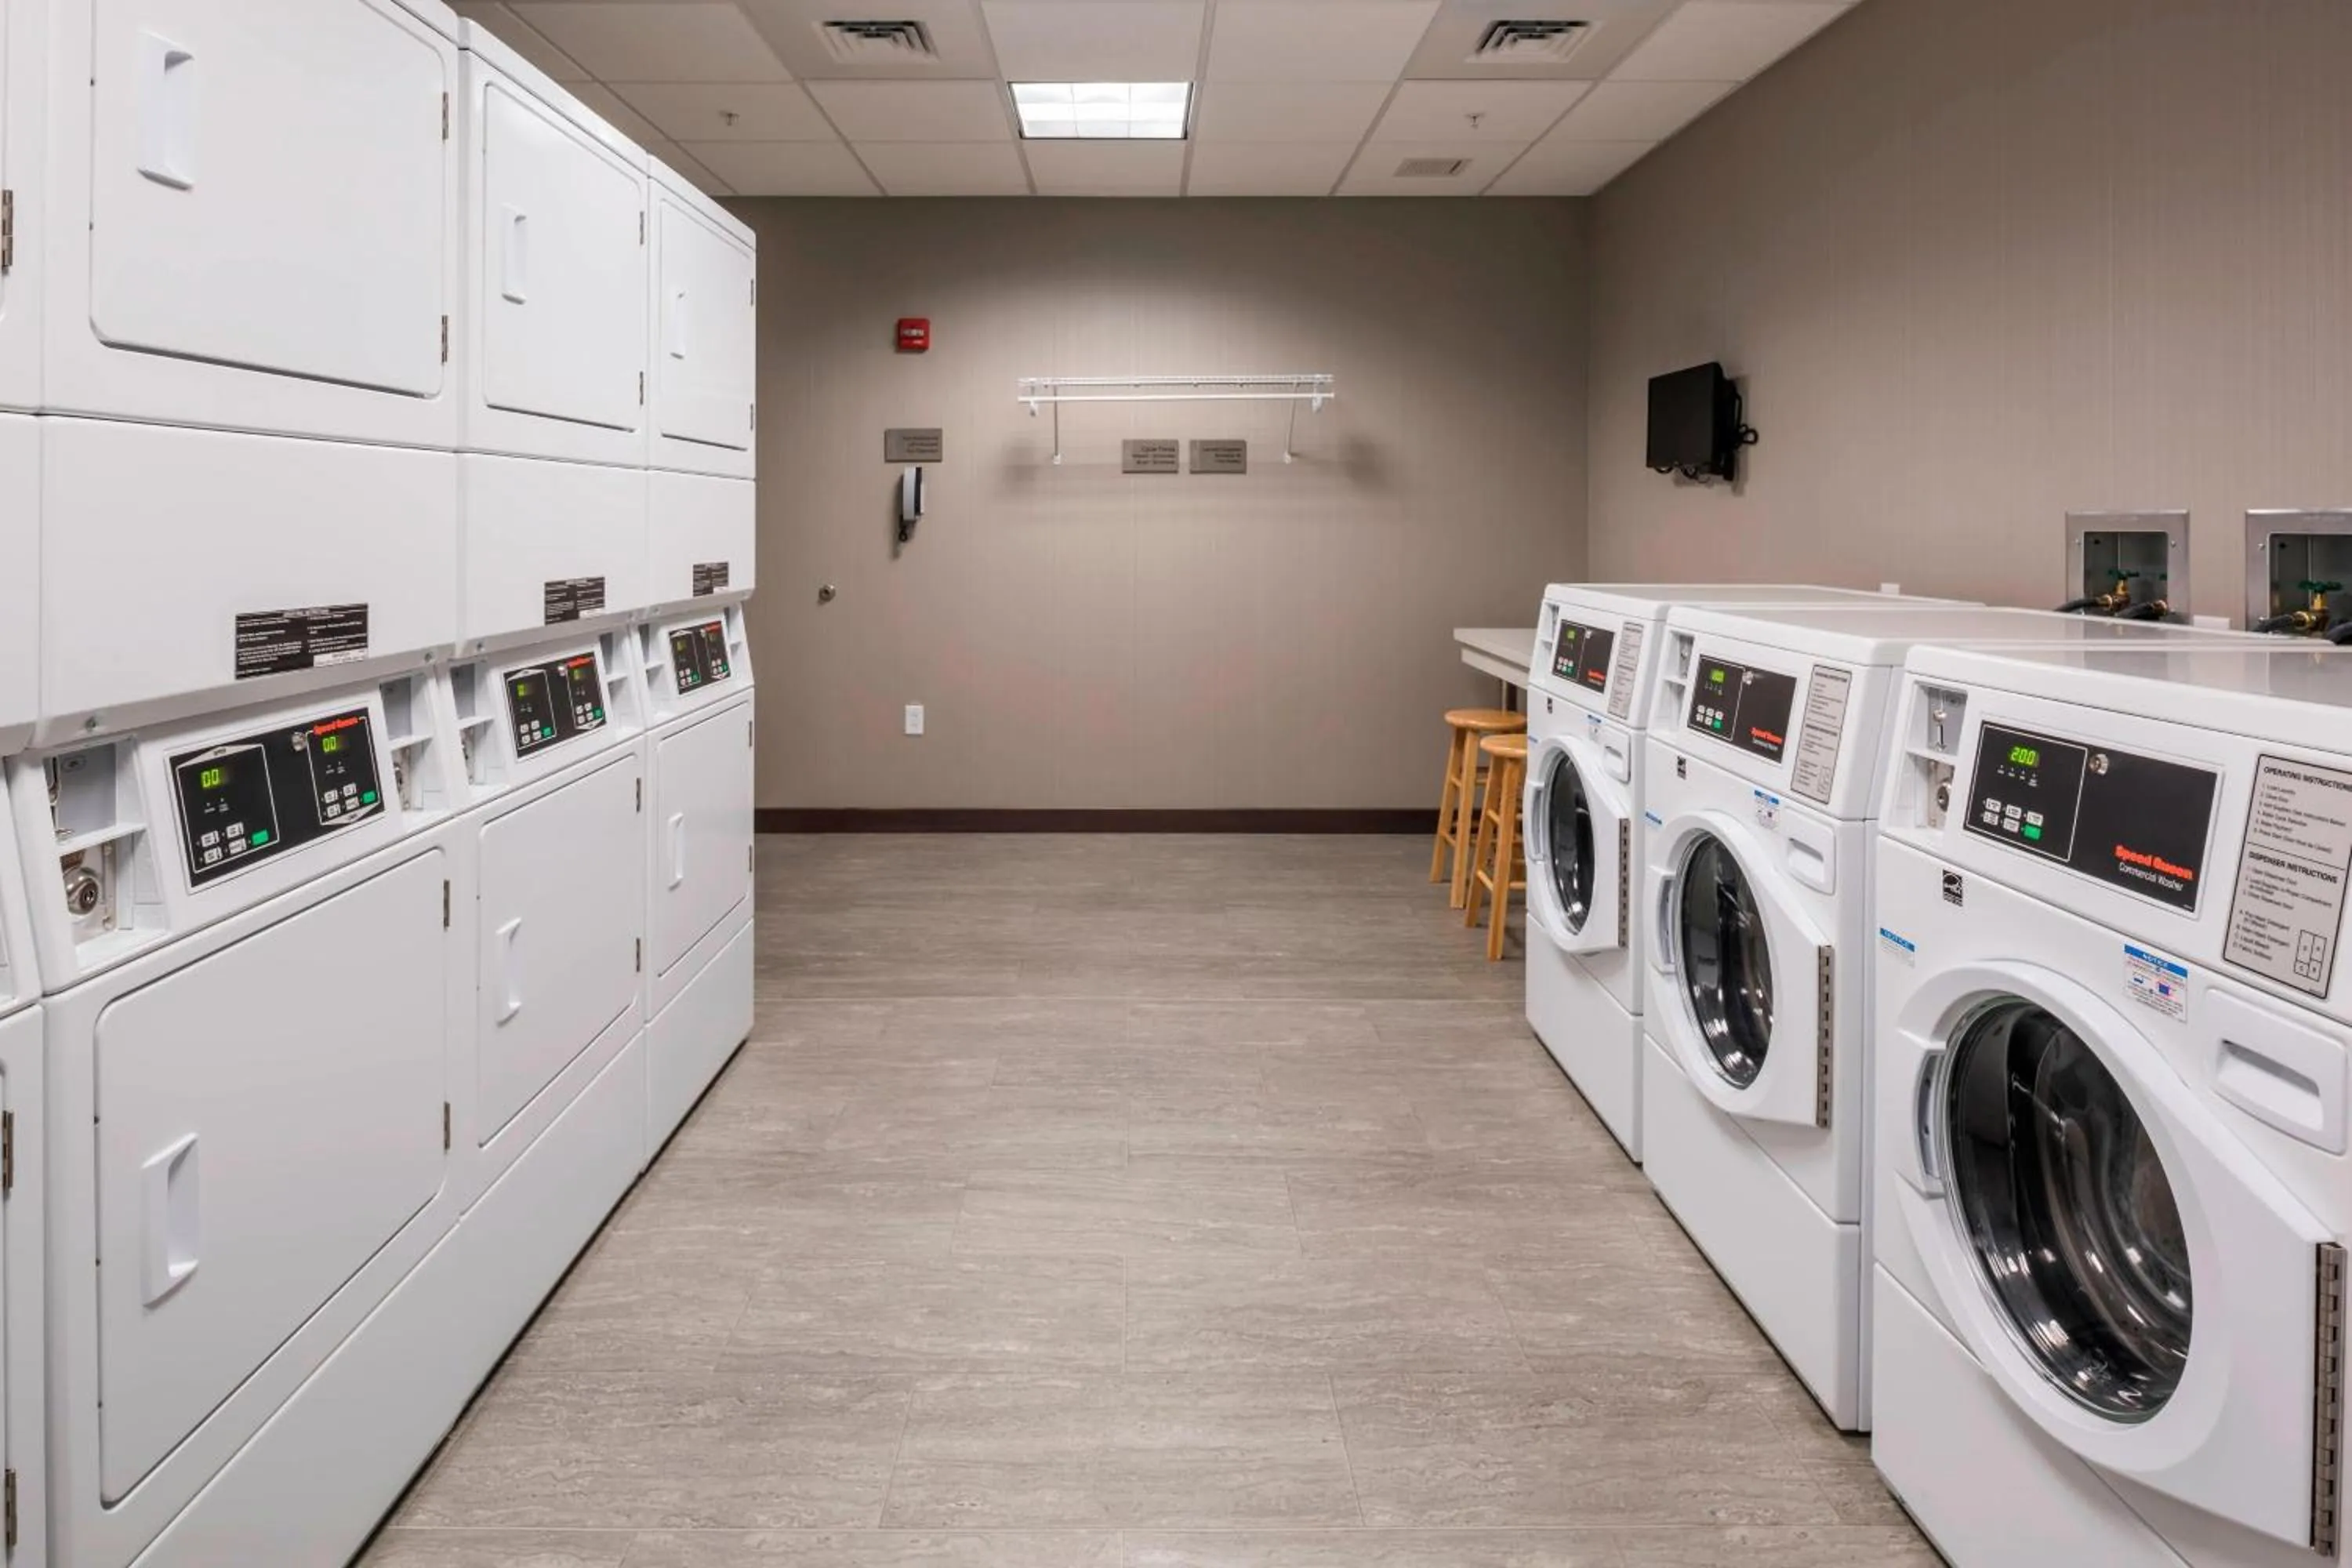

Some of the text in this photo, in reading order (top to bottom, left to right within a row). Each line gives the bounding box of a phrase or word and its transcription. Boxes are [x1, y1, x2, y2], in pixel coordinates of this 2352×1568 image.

[2010, 746, 2037, 766] 200
[2115, 845, 2193, 880] Speed Queen
[2286, 862, 2338, 884] INSTRUCTIONS
[2119, 862, 2183, 891] Commercial Washer
